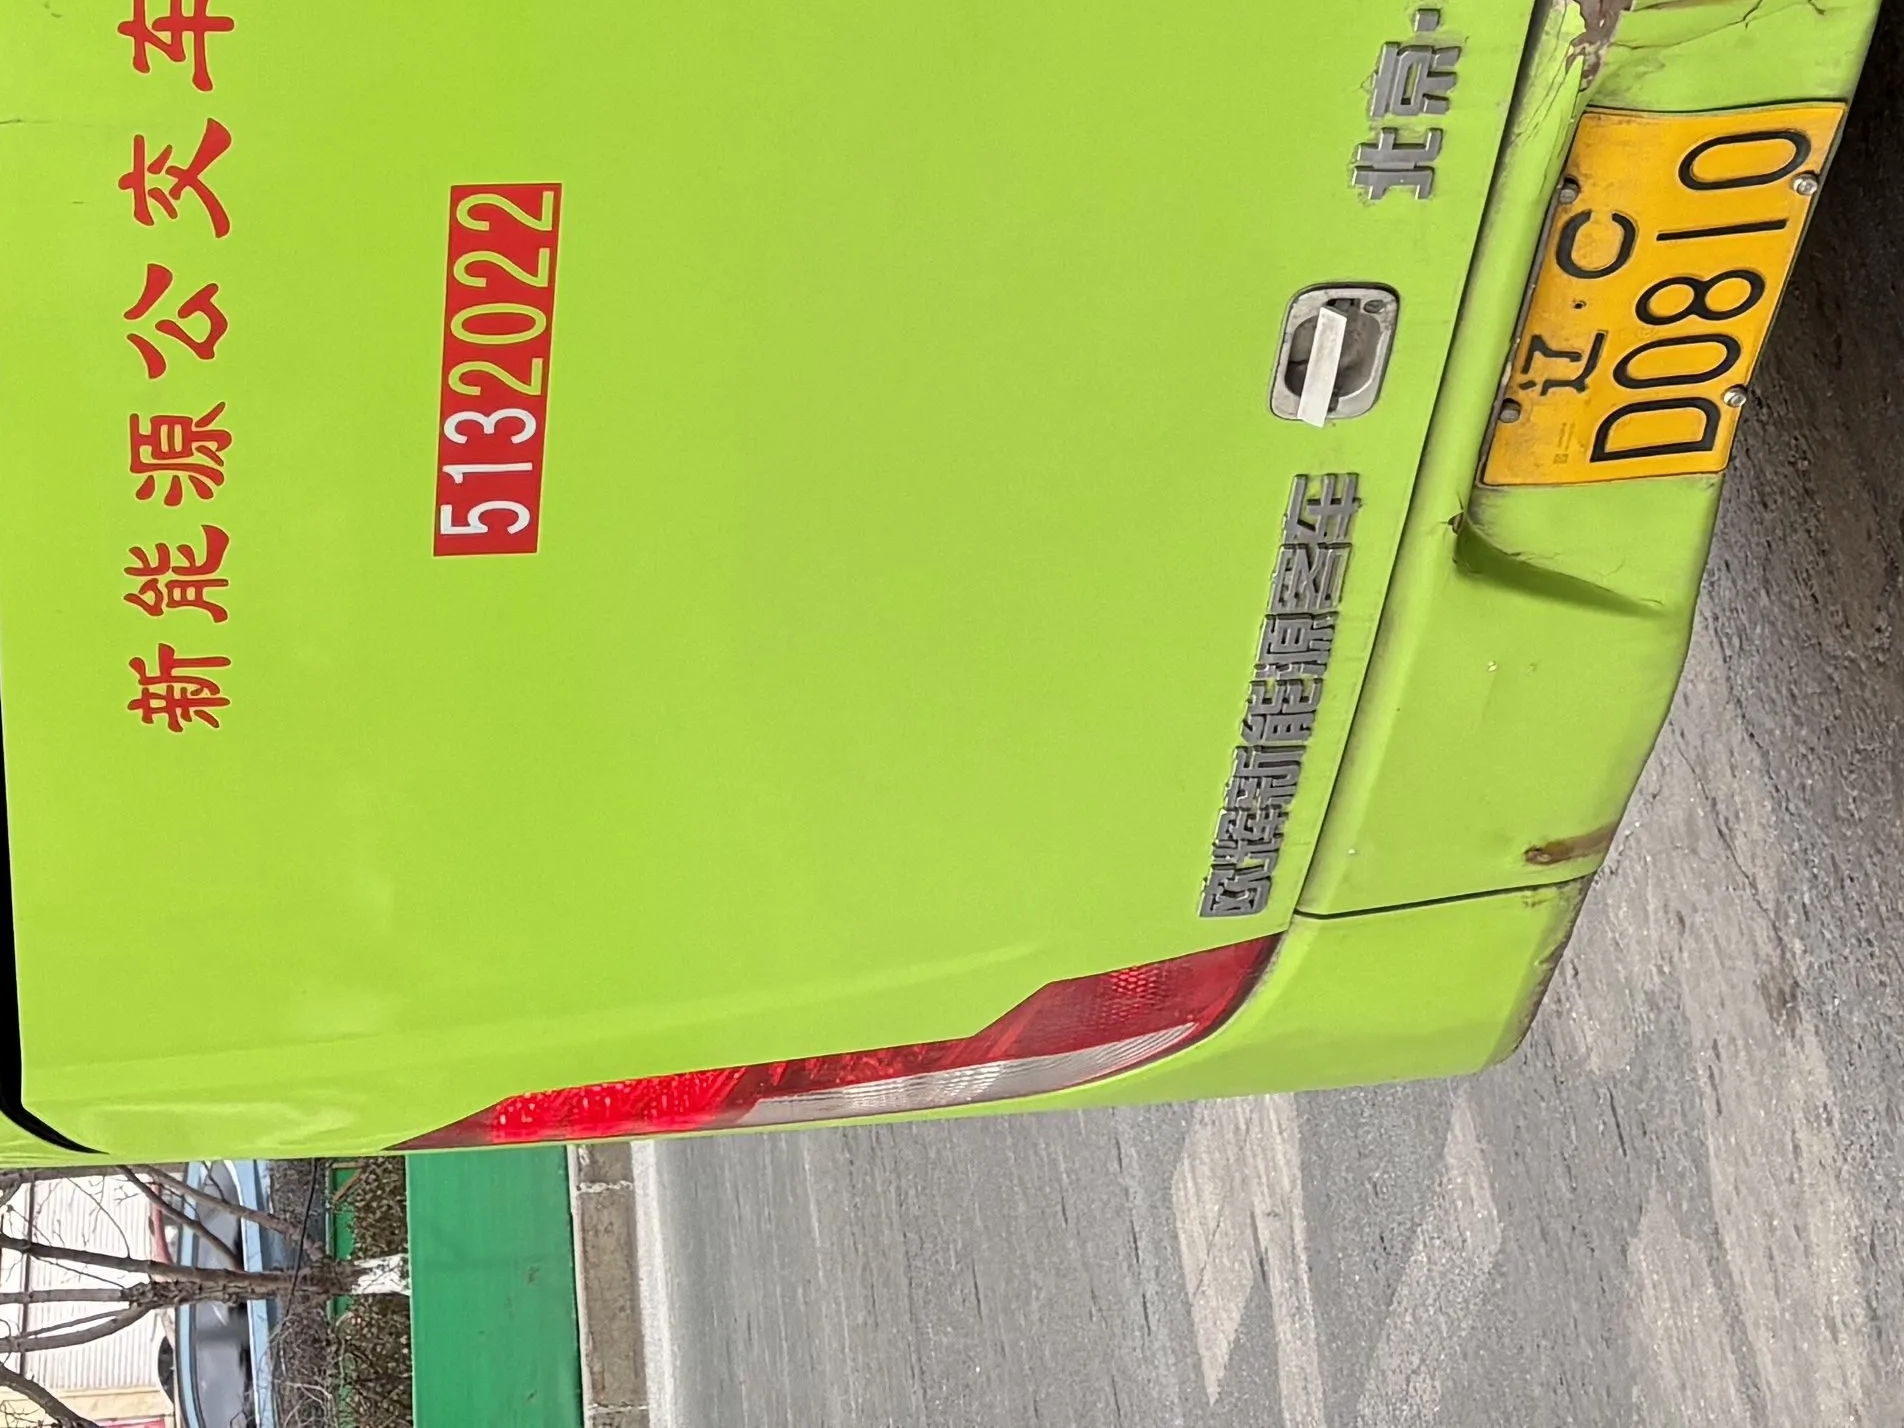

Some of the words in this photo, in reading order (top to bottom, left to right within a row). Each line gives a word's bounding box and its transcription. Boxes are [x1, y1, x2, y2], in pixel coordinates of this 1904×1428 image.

[440, 191, 554, 535] 5132022
[1589, 130, 1810, 463] D0810
[1197, 474, 1360, 917] 欧辉新能源客车
